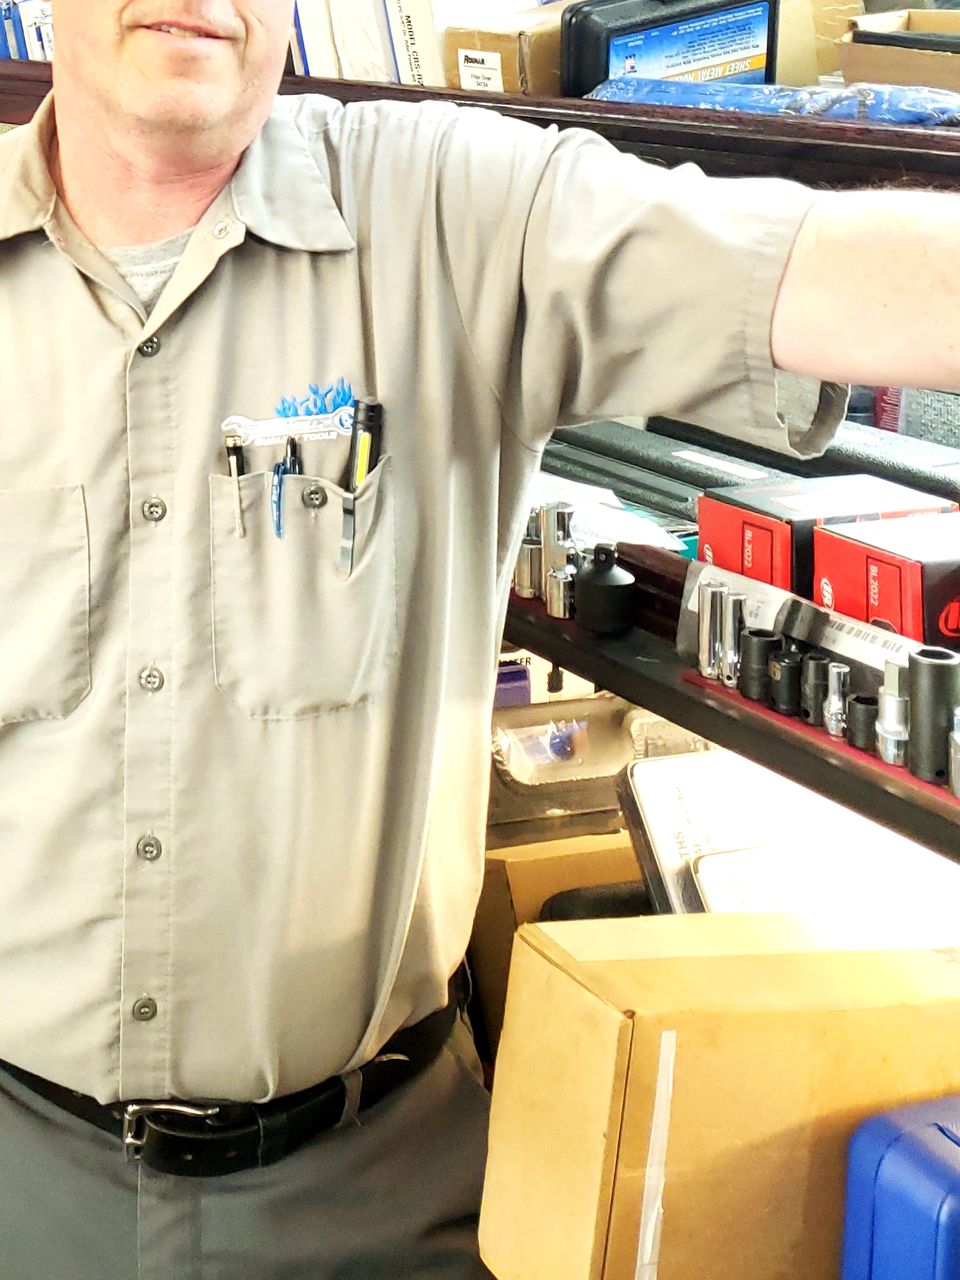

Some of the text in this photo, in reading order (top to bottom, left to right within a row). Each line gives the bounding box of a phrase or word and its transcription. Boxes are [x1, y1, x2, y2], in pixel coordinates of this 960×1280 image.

[405, 15, 416, 46] MODEL
[696, 66, 725, 82] METAL
[724, 58, 752, 76] SHEET
[303, 432, 338, 442] TOOLS
[743, 528, 755, 569] BL2022
[866, 563, 882, 607] BL2022
